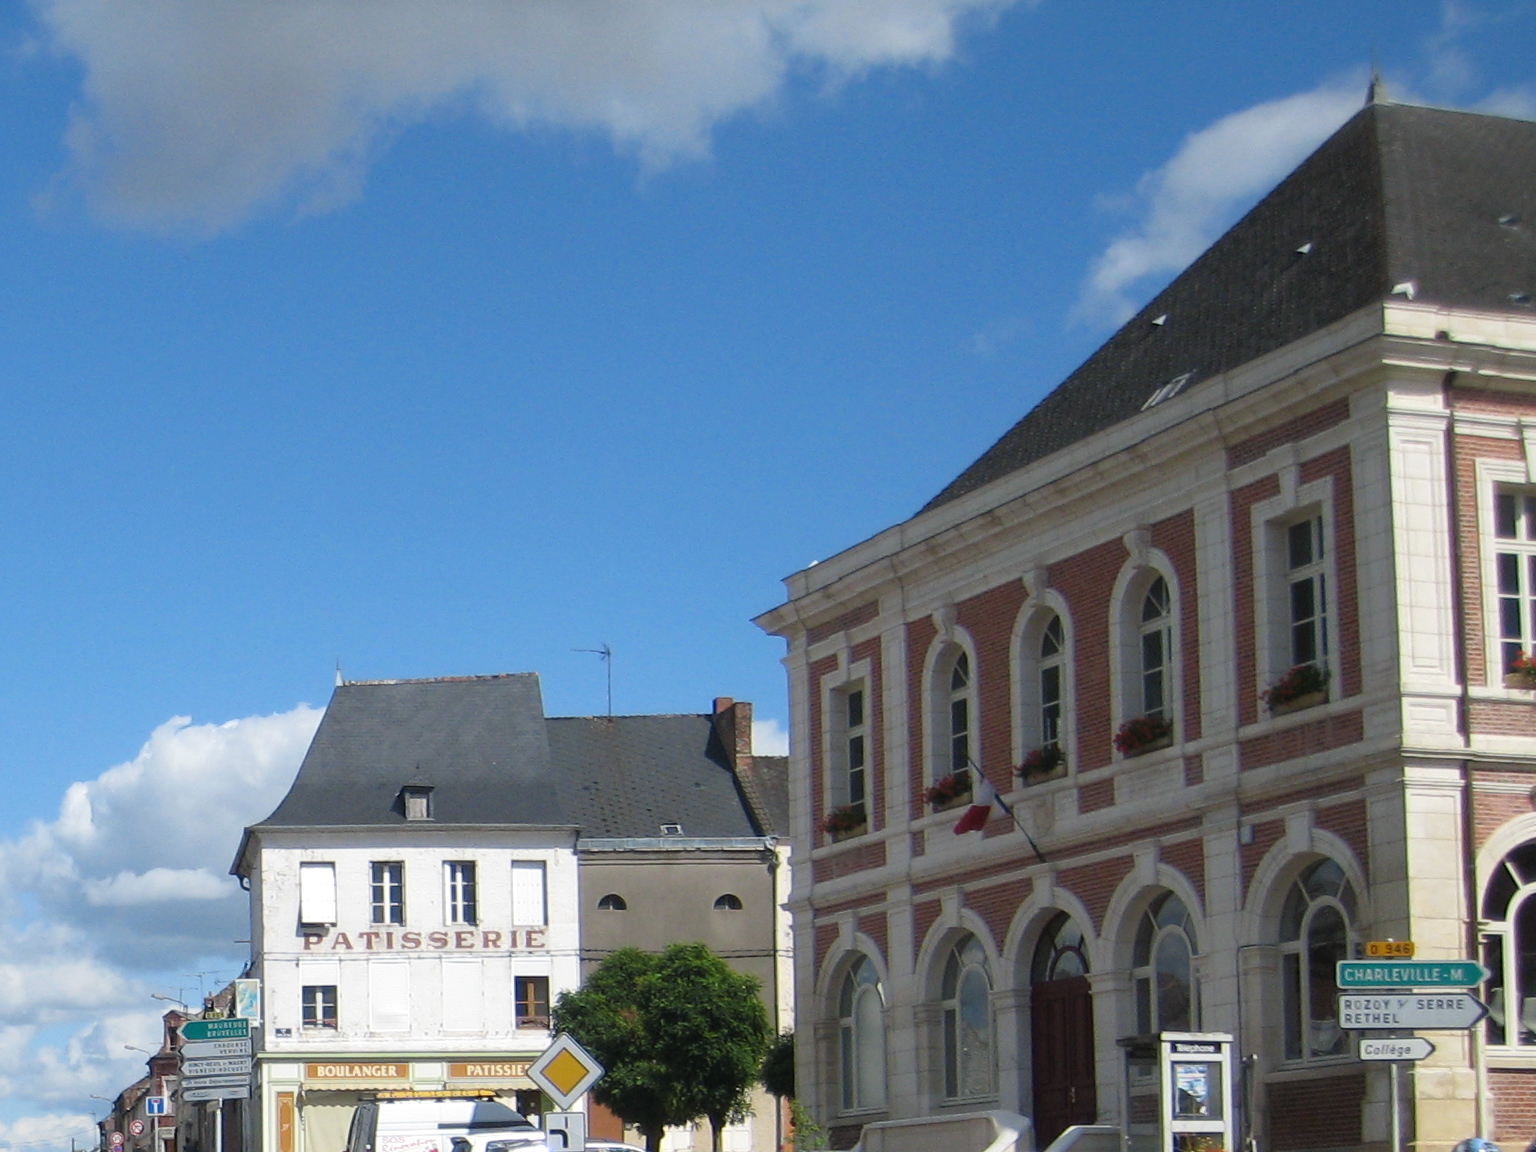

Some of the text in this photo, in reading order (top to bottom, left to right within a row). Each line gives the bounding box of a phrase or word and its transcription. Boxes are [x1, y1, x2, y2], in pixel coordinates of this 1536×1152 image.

[303, 930, 546, 950] PATISSERIE
[1370, 943, 1411, 955] D 946
[1344, 1000, 1390, 1010] ROZOY
[1417, 999, 1464, 1010] SERRE
[1344, 1013, 1400, 1024] RETHEL
[207, 1029, 247, 1038] BRUXELLES
[1364, 1044, 1412, 1057] Collège
[317, 1065, 398, 1078] BOULANGER
